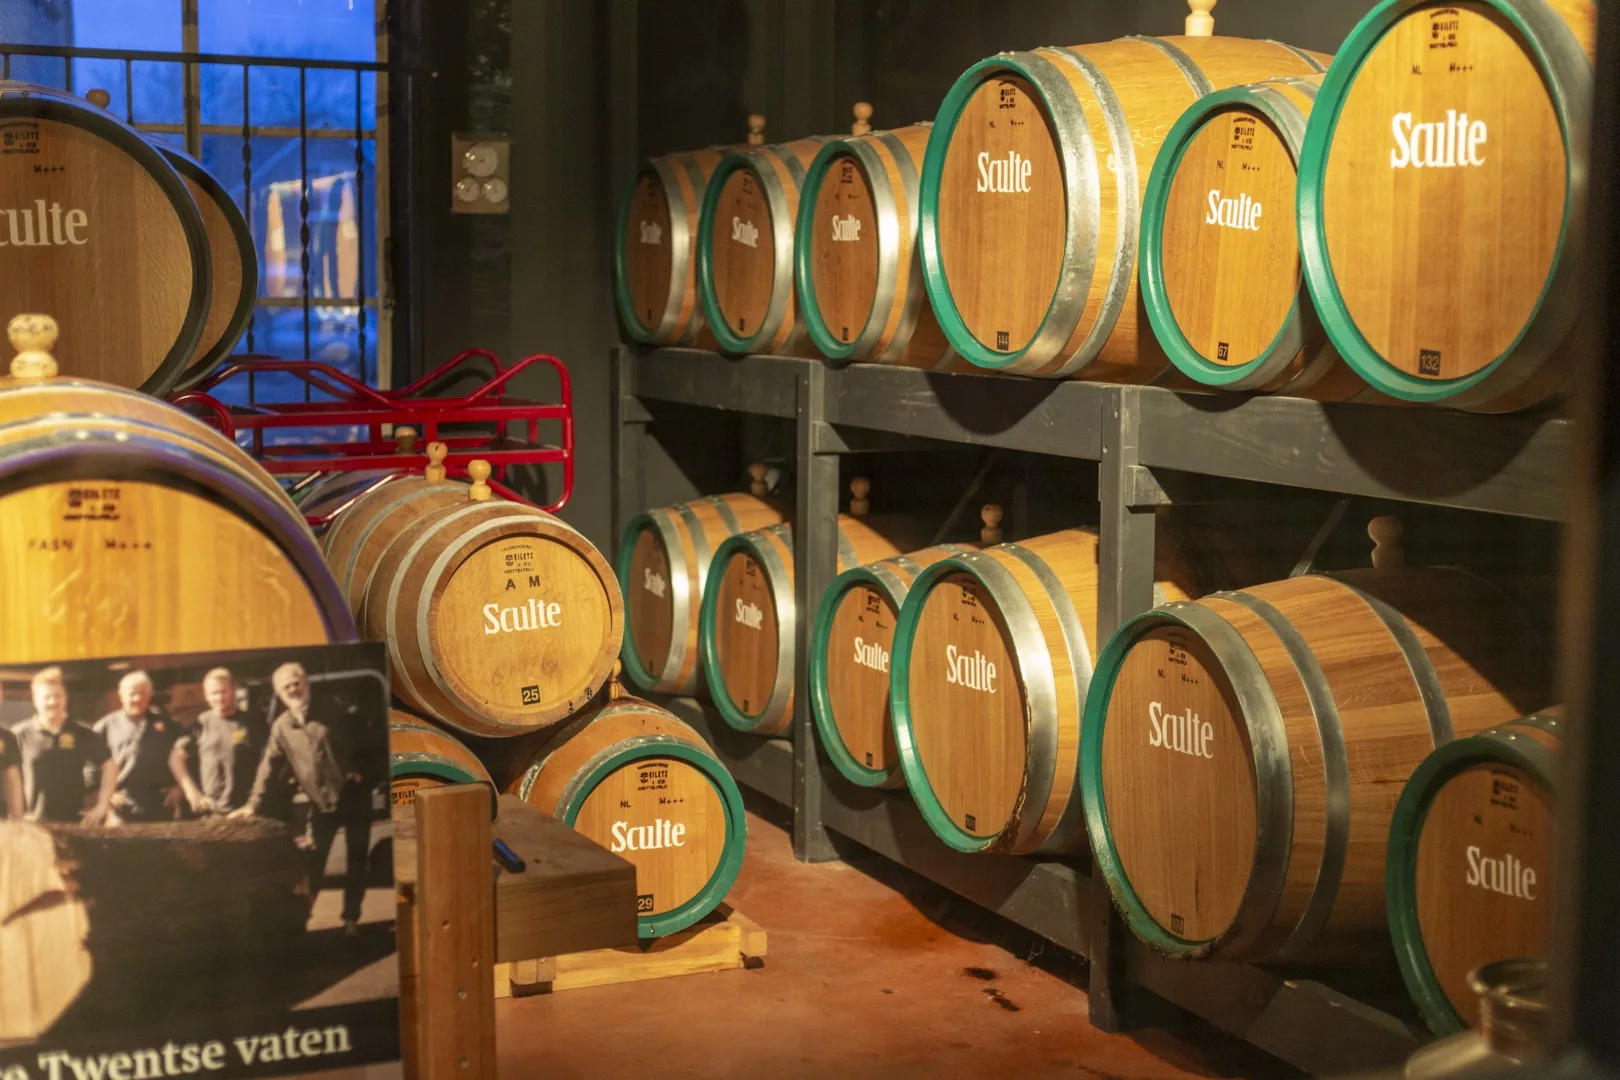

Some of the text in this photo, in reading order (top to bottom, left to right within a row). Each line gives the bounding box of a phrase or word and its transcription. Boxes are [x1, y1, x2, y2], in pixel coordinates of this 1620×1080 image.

[1412, 66, 1422, 75] NL
[1390, 109, 1487, 168] Sculte
[977, 151, 1032, 193] Sculte
[832, 214, 861, 241] Sculte
[1206, 189, 1262, 231] Sculte
[1219, 345, 1228, 358] 67
[1421, 354, 1439, 370] 132
[506, 575, 540, 590] A M
[483, 598, 561, 635] Sculte
[735, 598, 763, 630] Sculte
[854, 636, 889, 673] Sculte
[947, 644, 997, 694] Sculte
[522, 690, 539, 702] 25
[1149, 701, 1214, 759] Sculte
[399, 790, 415, 798] EILET
[611, 818, 686, 853] Sculte
[1466, 846, 1537, 900] Sculte
[638, 898, 653, 910] 29
[38, 1040, 225, 1080] Twentse
[234, 1024, 351, 1065] vaten
